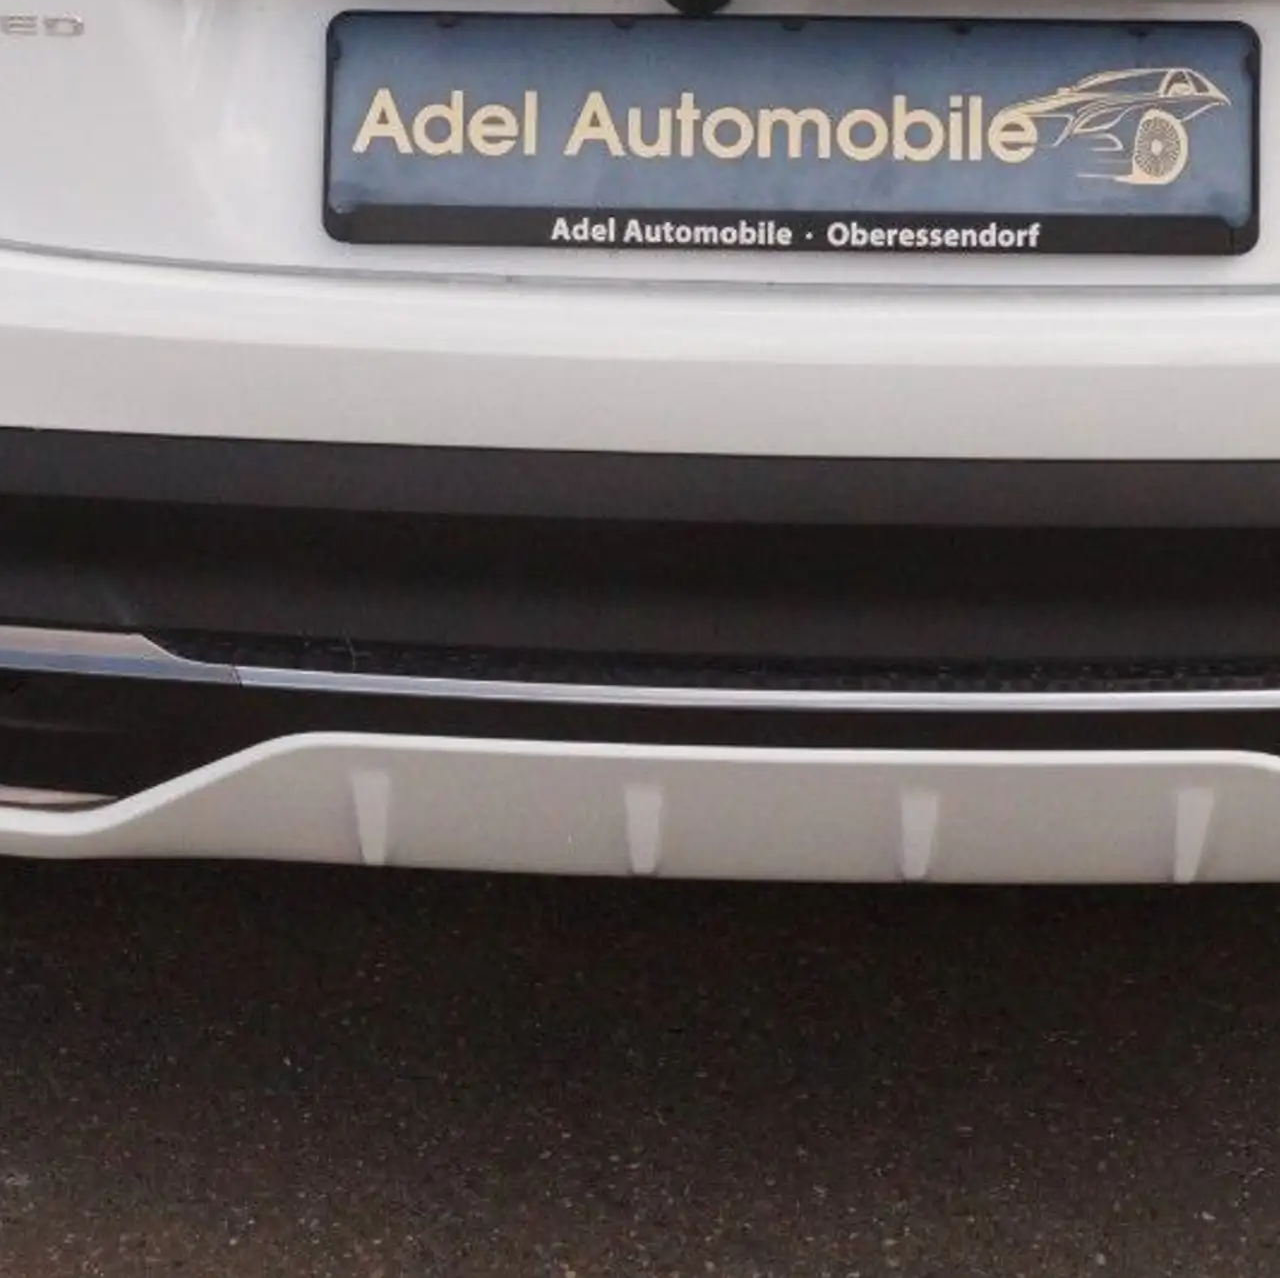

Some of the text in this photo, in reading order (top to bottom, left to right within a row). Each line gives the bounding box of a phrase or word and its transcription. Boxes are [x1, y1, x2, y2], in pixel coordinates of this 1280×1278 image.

[352, 87, 1038, 164] Adel Automobile
[550, 217, 1042, 248] Adel Automobile Oberessendorf
